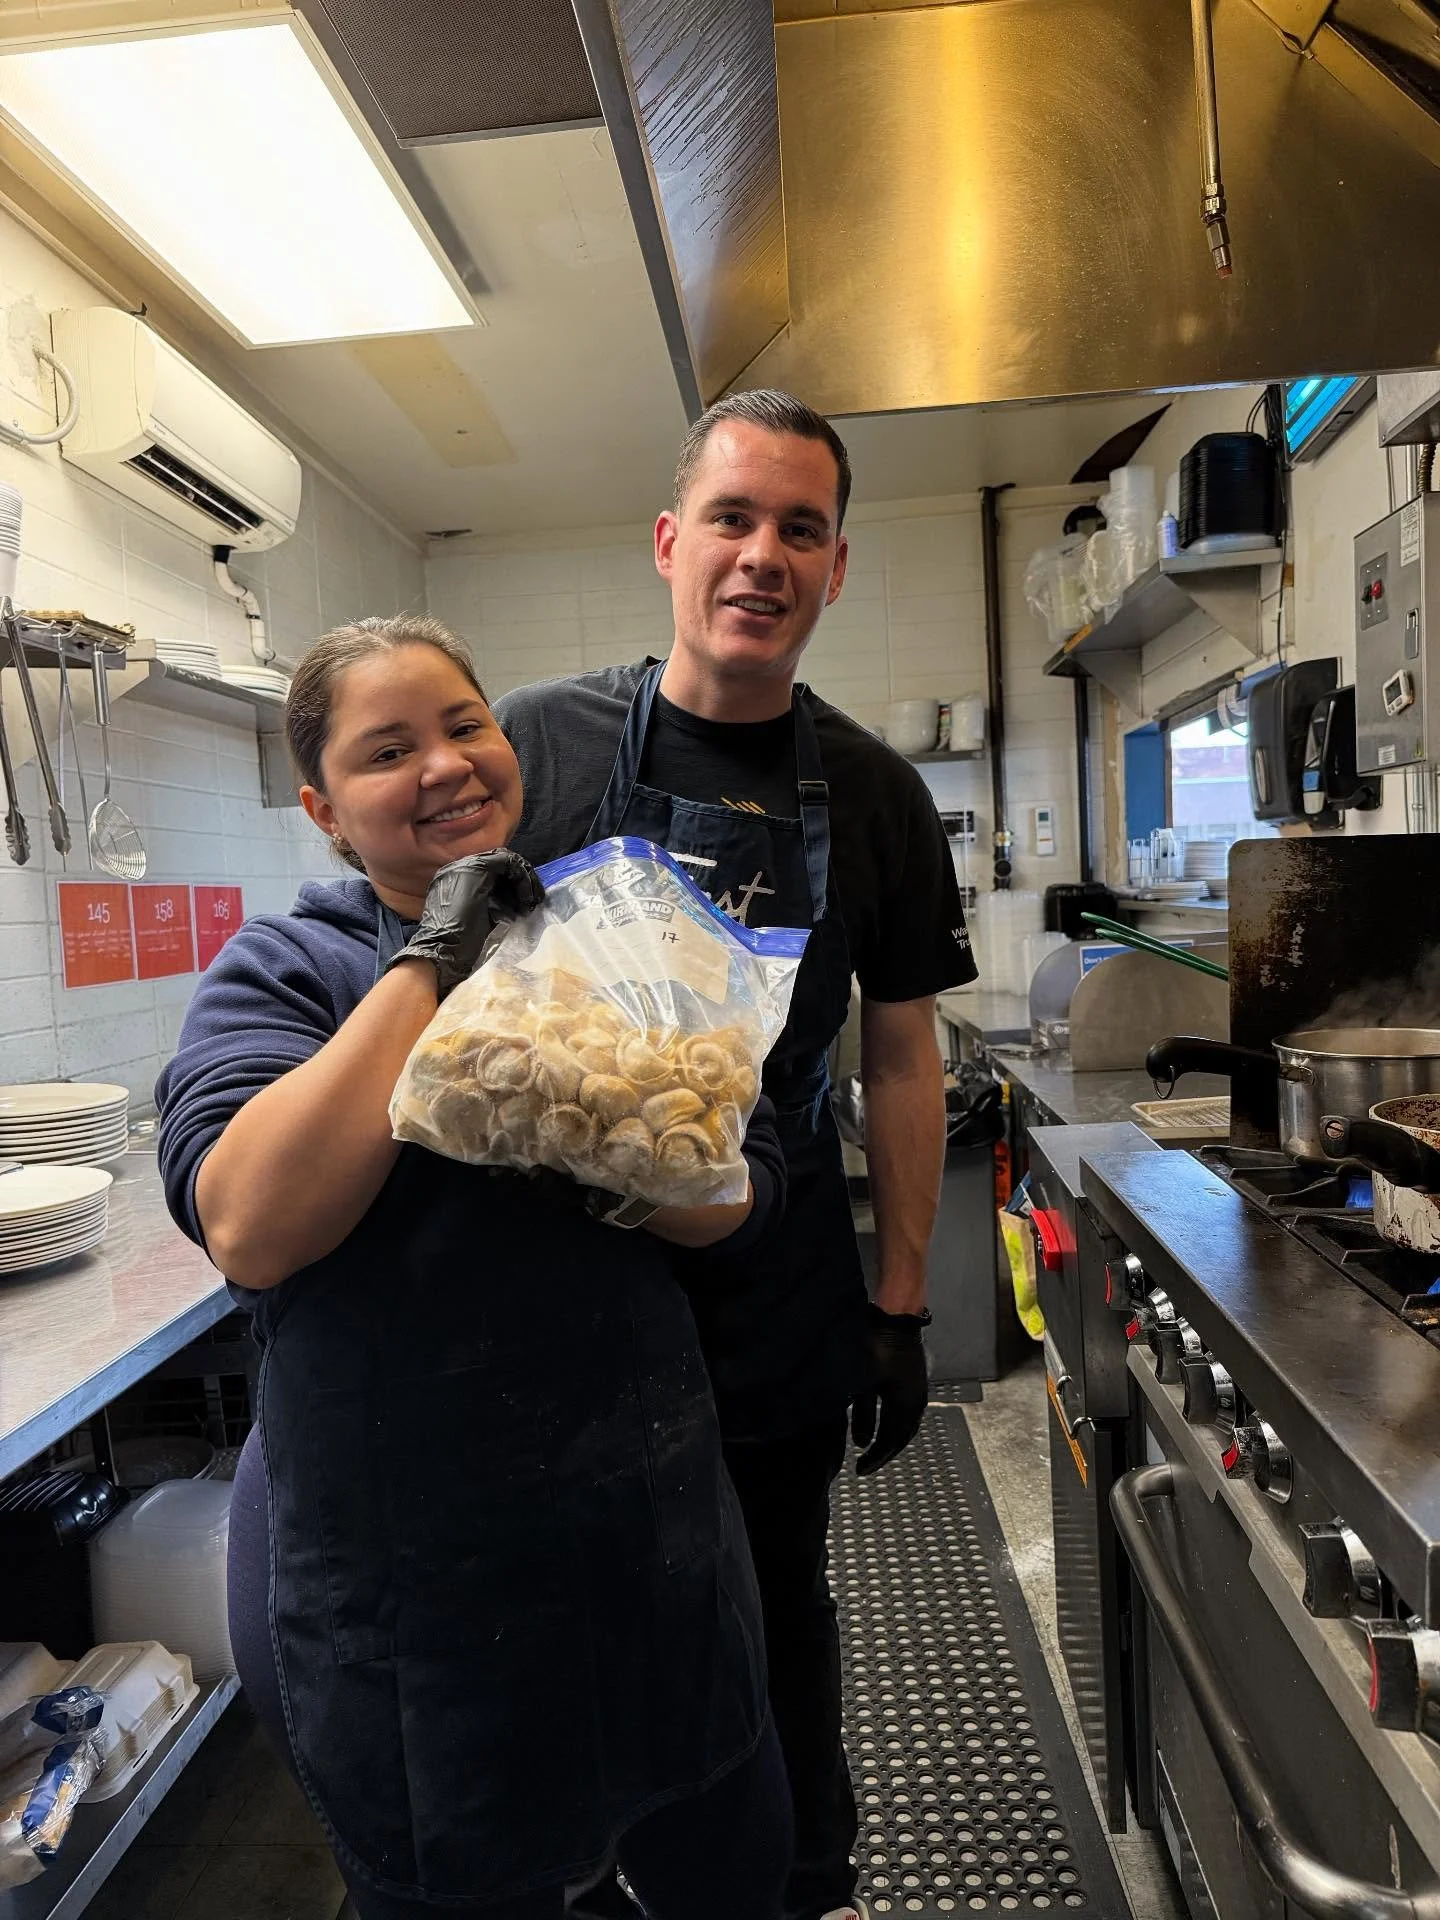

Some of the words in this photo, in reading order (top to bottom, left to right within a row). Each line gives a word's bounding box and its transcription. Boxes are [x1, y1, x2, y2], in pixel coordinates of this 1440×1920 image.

[87, 902, 110, 924] 145
[154, 899, 174, 922] 158
[213, 900, 230, 920] 165
[661, 931, 681, 944] 17
